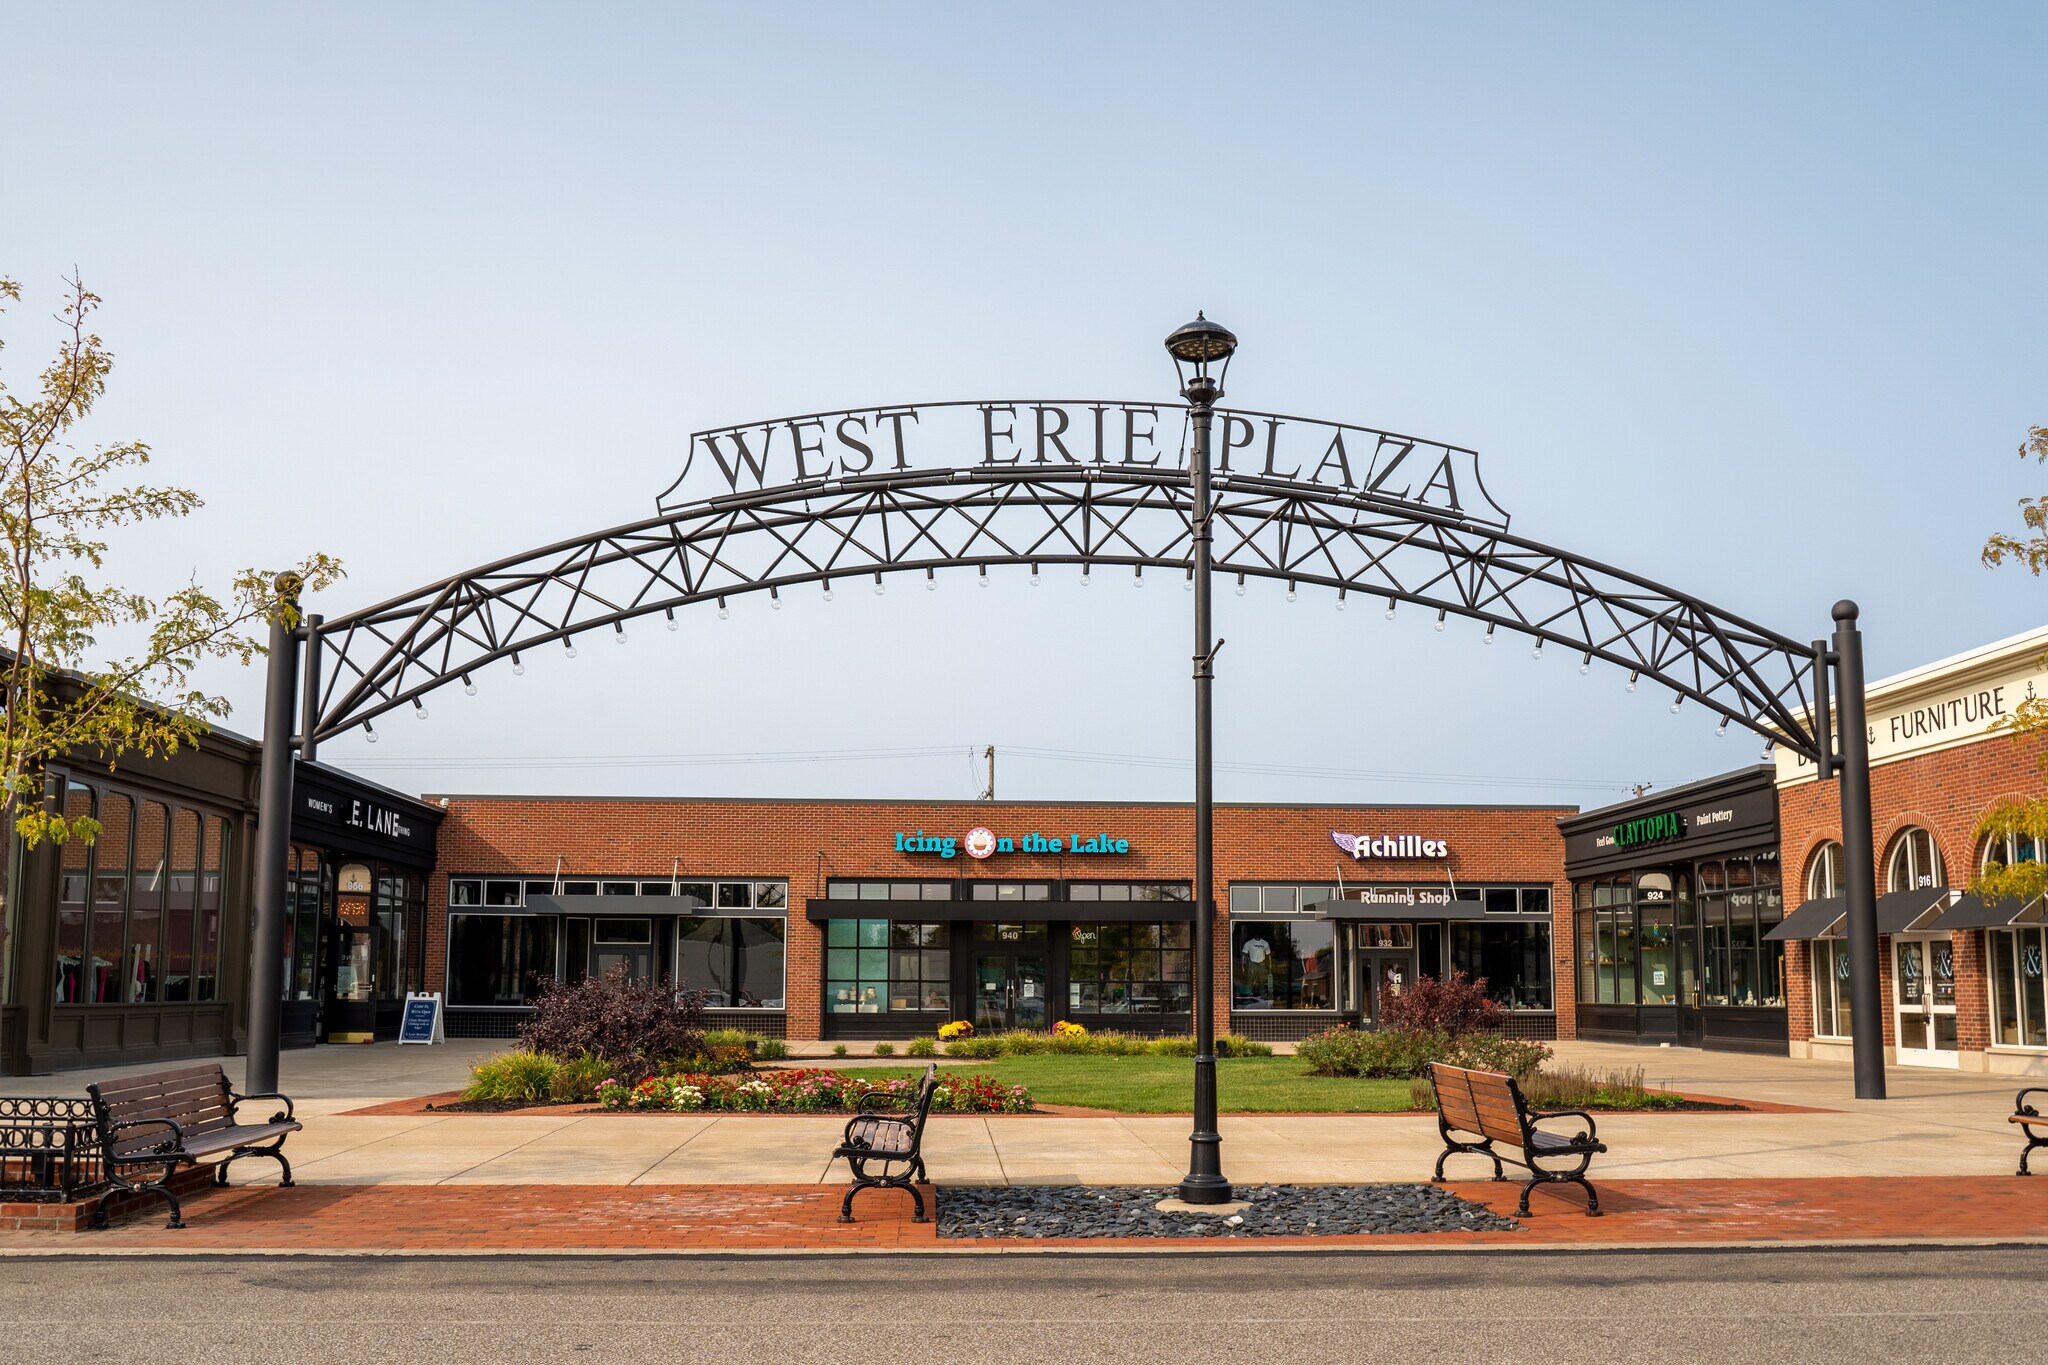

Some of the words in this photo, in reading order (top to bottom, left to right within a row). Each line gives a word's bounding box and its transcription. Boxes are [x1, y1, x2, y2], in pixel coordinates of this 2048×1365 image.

[699, 411, 920, 489] WEST
[977, 406, 1162, 466] ERIE
[1214, 415, 1465, 511] PLAZA
[1890, 686, 2006, 742] FURNITURE
[308, 798, 333, 814] WOMEN'S
[367, 804, 400, 838] LANE
[1696, 813, 1712, 826] Paint
[1712, 809, 1733, 823] Pottery
[1613, 811, 1679, 847] CLAYTOPIA
[895, 830, 957, 858] Icing
[1021, 832, 1063, 853] the
[1069, 833, 1129, 854] Lake
[1353, 835, 1448, 859] Achilles
[1596, 836, 1606, 848] Feel
[1606, 836, 1615, 846] Goo
[1918, 874, 1932, 887] 916
[1360, 891, 1415, 906] Running
[1419, 892, 1451, 906] Shop
[1647, 891, 1664, 900] 924
[1002, 931, 1018, 940] 940
[1073, 927, 1096, 944] Open
[1378, 939, 1393, 947] 932
